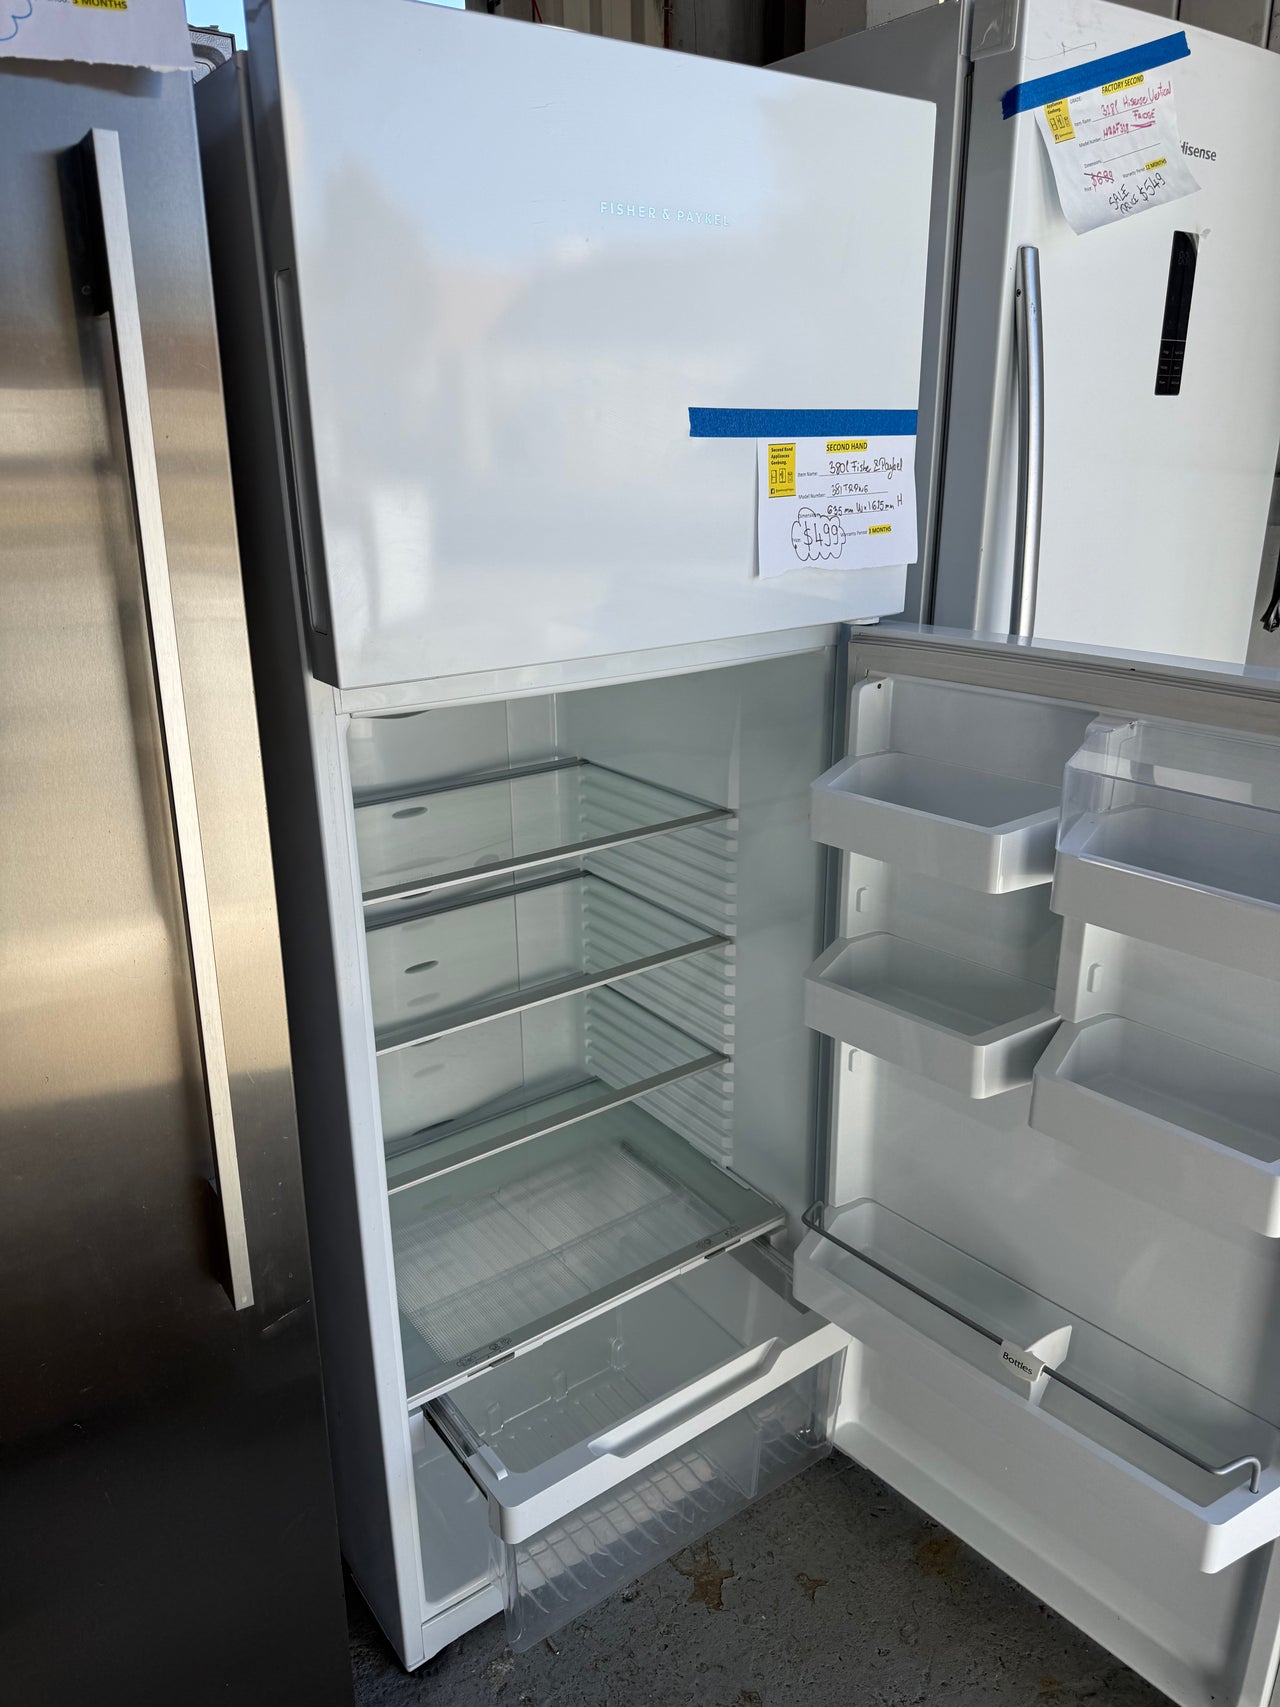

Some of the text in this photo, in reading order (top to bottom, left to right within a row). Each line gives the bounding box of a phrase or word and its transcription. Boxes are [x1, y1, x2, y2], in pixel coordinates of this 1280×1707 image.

[81, 0, 128, 9] MONTHS
[1102, 75, 1144, 94] FACTORY SECOND
[1122, 94, 1148, 109] Hisense
[1147, 80, 1172, 102] Vertical
[1151, 159, 1168, 168] MONTHS
[1109, 184, 1129, 210] SALE
[1120, 172, 1166, 214] PRICE $549
[600, 201, 729, 226] FISHER & PAYKEL
[826, 441, 868, 452] SECOND HAND
[803, 521, 838, 551] $499
[1002, 1351, 1033, 1375] Bottles
